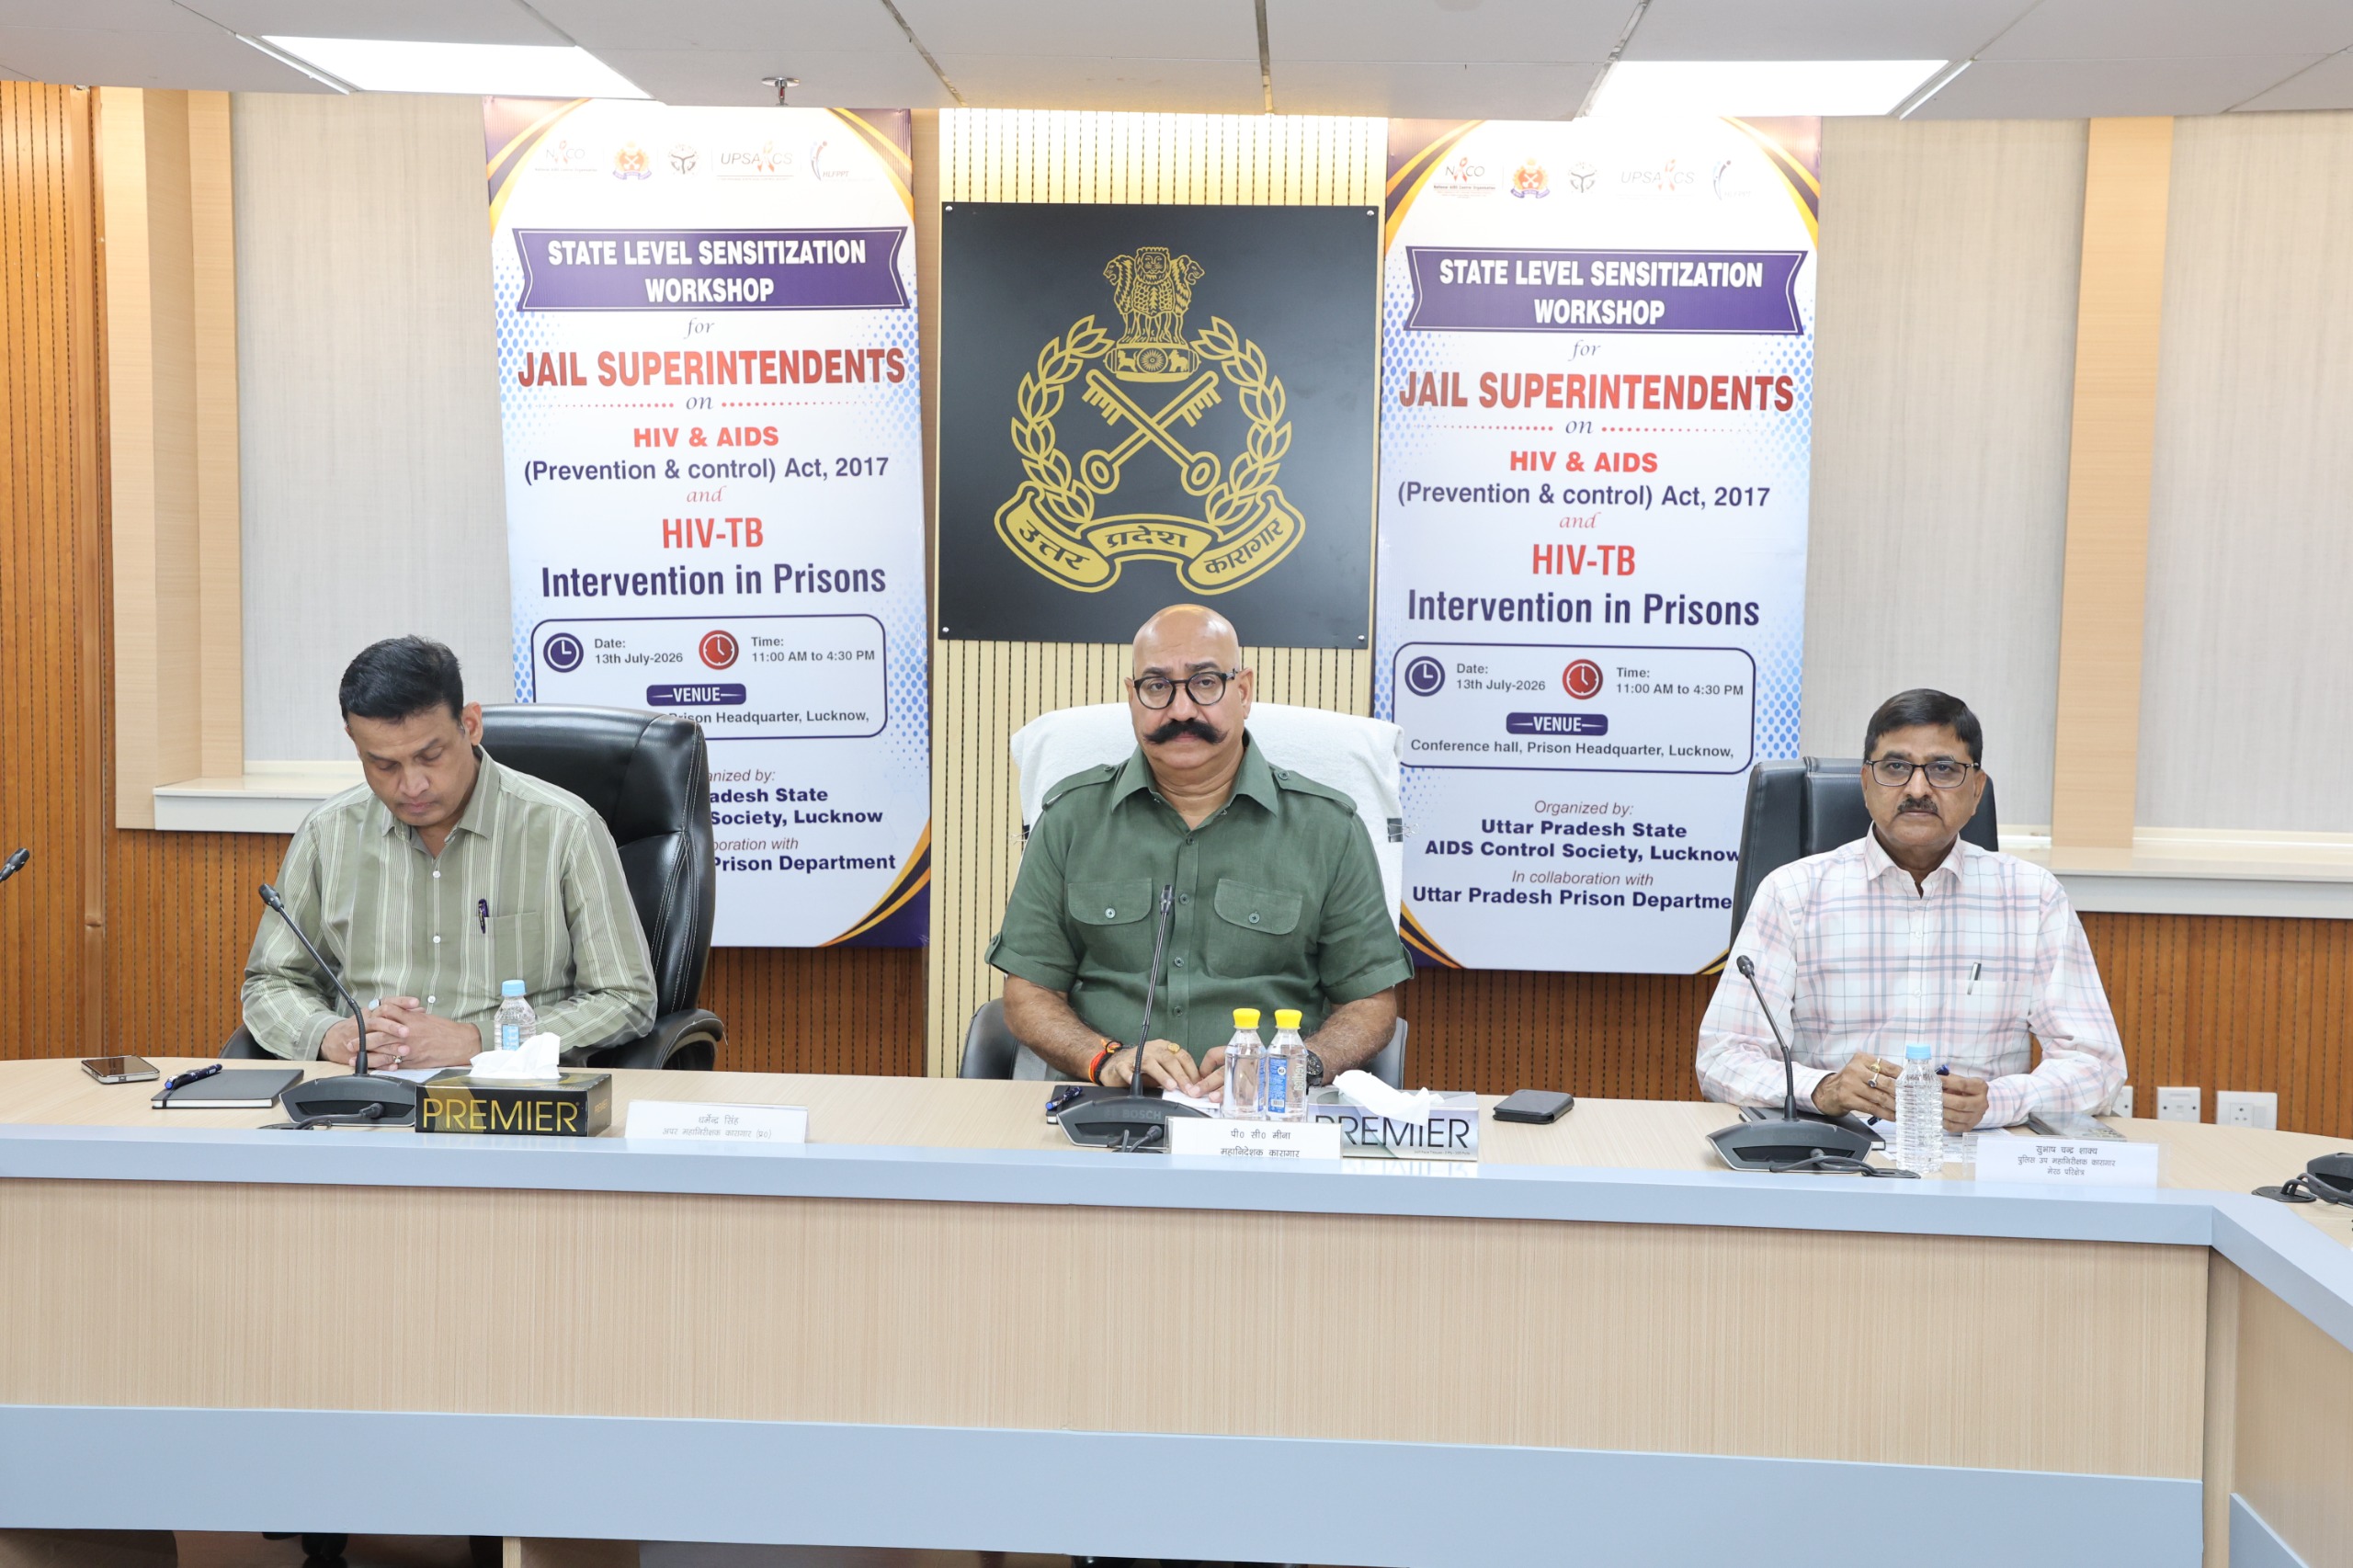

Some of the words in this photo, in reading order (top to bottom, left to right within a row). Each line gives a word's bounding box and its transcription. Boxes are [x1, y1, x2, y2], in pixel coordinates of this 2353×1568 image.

[548, 240, 618, 266] STATE
[623, 239, 694, 266] LEVEL
[698, 239, 867, 266] SENSITIZATION
[1439, 258, 1509, 285] STATE
[1515, 259, 1585, 286] LEVEL
[1590, 260, 1763, 288] SENSITIZATION
[643, 277, 775, 303] WORKSHOP
[1533, 298, 1665, 326] WORKSHOP
[686, 317, 715, 340] for
[1570, 339, 1601, 362] for
[517, 349, 588, 388] JAIL
[597, 347, 905, 387] SUPERINTENDENTS
[1399, 369, 1469, 409] JAIL
[1479, 370, 1794, 412] SUPERINTENDENTS
[686, 396, 713, 410] on
[1564, 420, 1594, 435] on
[633, 427, 679, 449] HIV
[688, 426, 709, 448] &
[716, 426, 779, 448] AIDS
[524, 460, 656, 486] (Prevention
[664, 459, 680, 480] &
[688, 458, 776, 483] control)
[784, 457, 828, 482] Act,
[835, 456, 889, 477] 2017
[1509, 450, 1557, 472] HIV
[1565, 450, 1586, 472] &
[1593, 451, 1658, 473] AIDS
[686, 485, 727, 503] and
[1398, 481, 1530, 507] (Prevention
[1539, 483, 1555, 505] &
[1563, 484, 1653, 511] control)
[1661, 485, 1706, 510] Act,
[1713, 486, 1771, 507] 2017
[1559, 511, 1602, 529] and
[662, 517, 764, 549] HIV-TB
[1018, 520, 1090, 570] उत्तर
[1105, 525, 1188, 548] प्रदेश
[1203, 517, 1283, 574] कारागार
[1532, 543, 1636, 576] HIV-TB
[541, 564, 724, 597] Intervention
[735, 563, 762, 595] in
[774, 562, 886, 594] Prisons
[1408, 588, 1592, 623] Intervention
[1605, 592, 1631, 624] in
[1643, 593, 1760, 627] Prisons
[594, 638, 626, 649] Date:
[750, 636, 784, 647] Time:
[595, 653, 621, 665] 13th
[624, 652, 684, 666] July-2026
[752, 651, 785, 663] 11:00
[788, 651, 808, 662] AM
[811, 651, 824, 662] to
[826, 650, 852, 661] 4:30
[856, 650, 875, 661] PM
[1456, 663, 1488, 675] Date:
[1616, 666, 1650, 678] Time:
[672, 686, 722, 704] VENUE
[1456, 678, 1483, 690] 13th
[1485, 678, 1546, 693] July-2026
[1617, 683, 1650, 694] 11:00
[1653, 683, 1674, 695] AM
[1677, 684, 1690, 695] to
[1693, 684, 1720, 696] 4:30
[1723, 684, 1744, 696] PM
[716, 710, 802, 726] Headquarter,
[806, 710, 870, 722] Lucknow,
[1530, 715, 1585, 733] VENUE
[1410, 738, 1490, 752] Conference
[1494, 741, 1523, 754] hall,
[1527, 741, 1572, 754] Prison
[1575, 742, 1665, 758] Headquarter,
[1668, 744, 1733, 758] Lucknow,
[709, 769, 751, 781] anized
[755, 768, 776, 785] by:
[710, 788, 769, 802] adesh
[775, 788, 828, 802] State
[793, 809, 883, 824] Lucknow
[1534, 800, 1609, 817] Organized
[1611, 801, 1634, 818] by:
[1481, 818, 1534, 835] Uttar
[1540, 820, 1625, 836] Pradesh
[1632, 822, 1688, 838] State
[771, 837, 799, 850] with
[1425, 840, 1474, 856] AIDS
[1480, 841, 1555, 858] Control
[1562, 843, 1643, 864] Society,
[1650, 845, 1740, 862] Lucknow
[779, 854, 896, 875] Department
[1511, 869, 1526, 883] In
[1529, 870, 1620, 885] collaboration
[1625, 873, 1654, 886] with
[1413, 885, 1462, 903] Uttar
[1469, 887, 1552, 904] Pradesh
[1560, 889, 1625, 907] Prison
[1631, 891, 1733, 912] Departme
[422, 1097, 578, 1133] PREMIER
[724, 1115, 738, 1125] सिंह
[1122, 1109, 1162, 1120] BOSCH
[1272, 1130, 1290, 1140] मीना
[1316, 1115, 1470, 1148] REMIER
